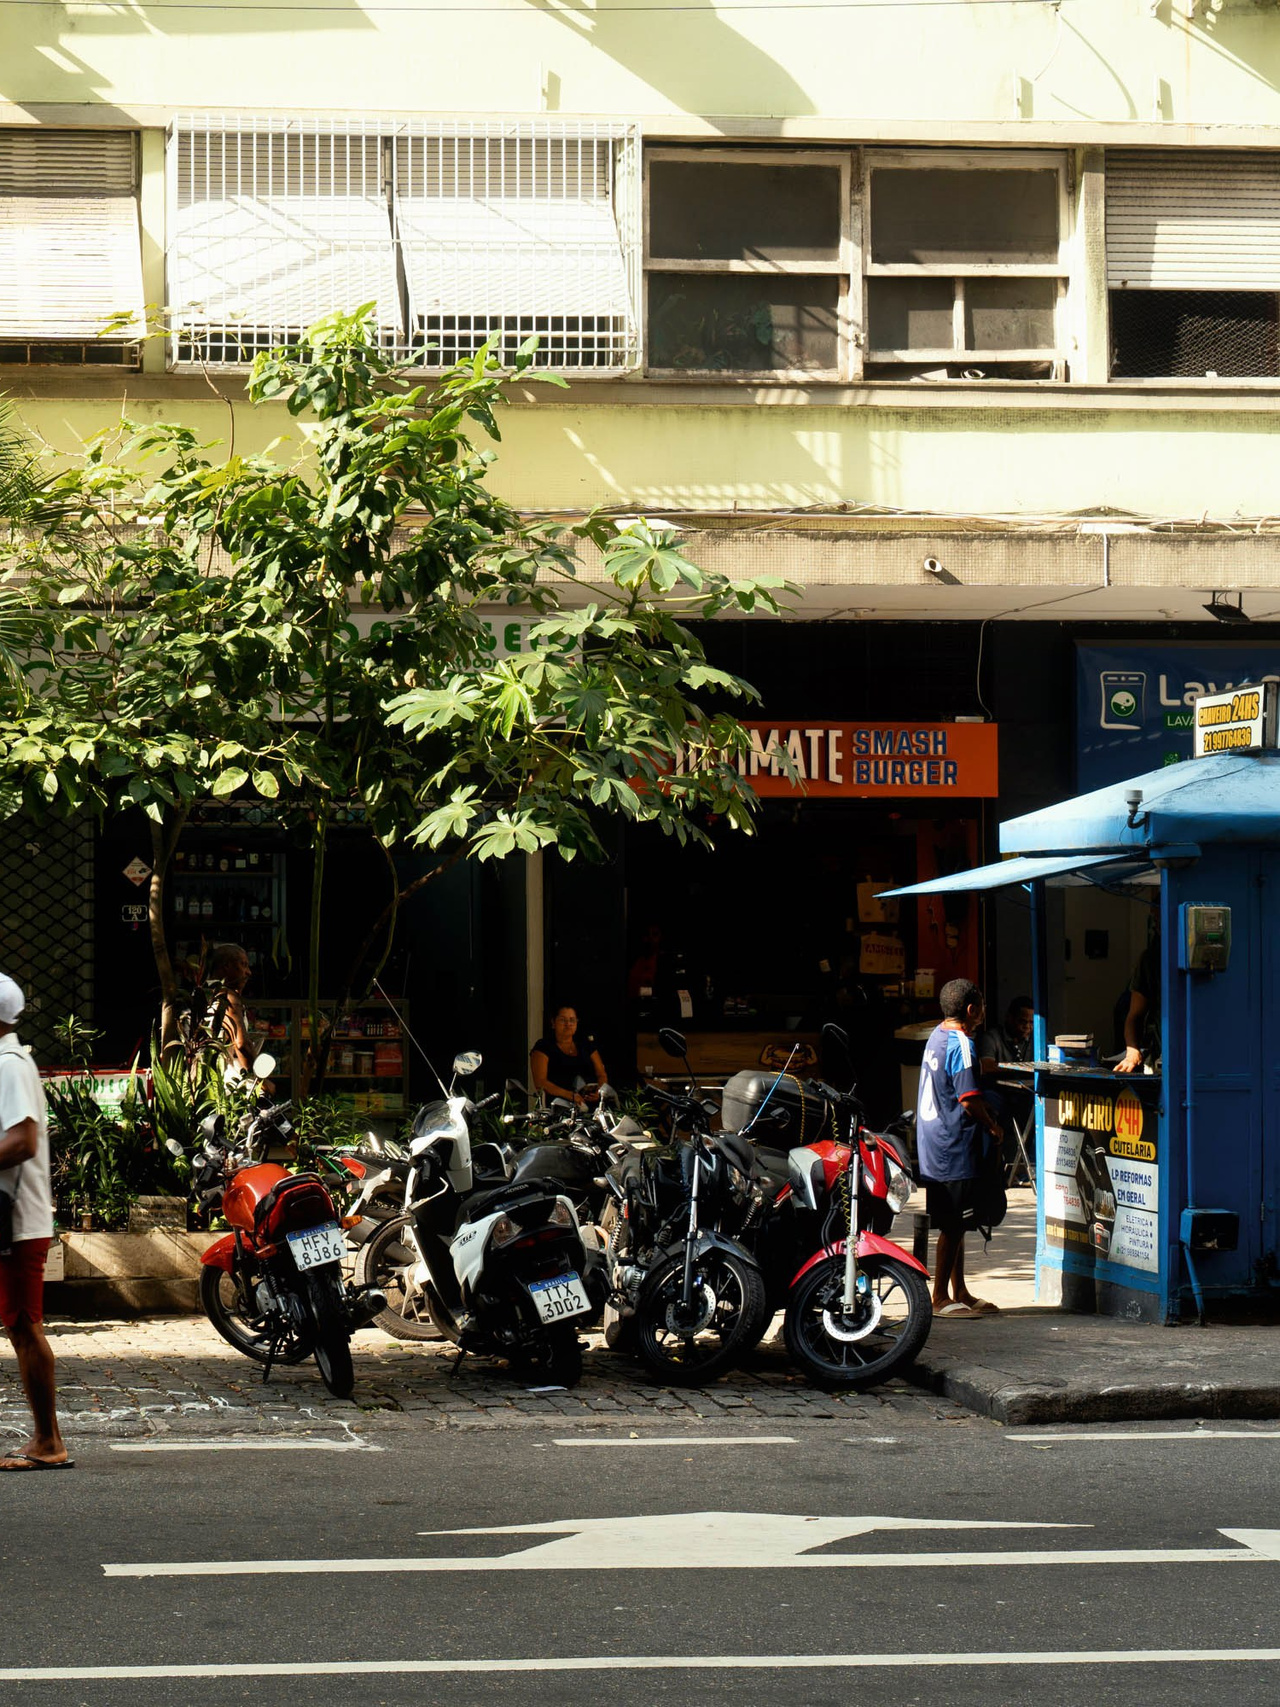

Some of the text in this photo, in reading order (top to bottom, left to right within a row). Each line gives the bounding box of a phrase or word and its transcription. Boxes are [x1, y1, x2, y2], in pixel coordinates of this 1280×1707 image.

[1198, 691, 1260, 727] CHAVEIRO 24HS
[853, 730, 948, 755] SMASH
[675, 729, 842, 784] UIMATE
[853, 759, 958, 785] BURGER
[128, 905, 143, 915] 120
[1059, 1090, 1140, 1137] CHAVEIRO 24H
[1113, 1140, 1152, 1158] CUTELARIA
[1111, 1168, 1152, 1187] LP REFORMAS
[1117, 1189, 1146, 1205] EM GERAL
[1129, 1237, 1149, 1249] PINTURA
[302, 1243, 341, 1265] 8J86
[543, 1282, 574, 1302] TTX
[544, 1279, 564, 1288] BRASIL
